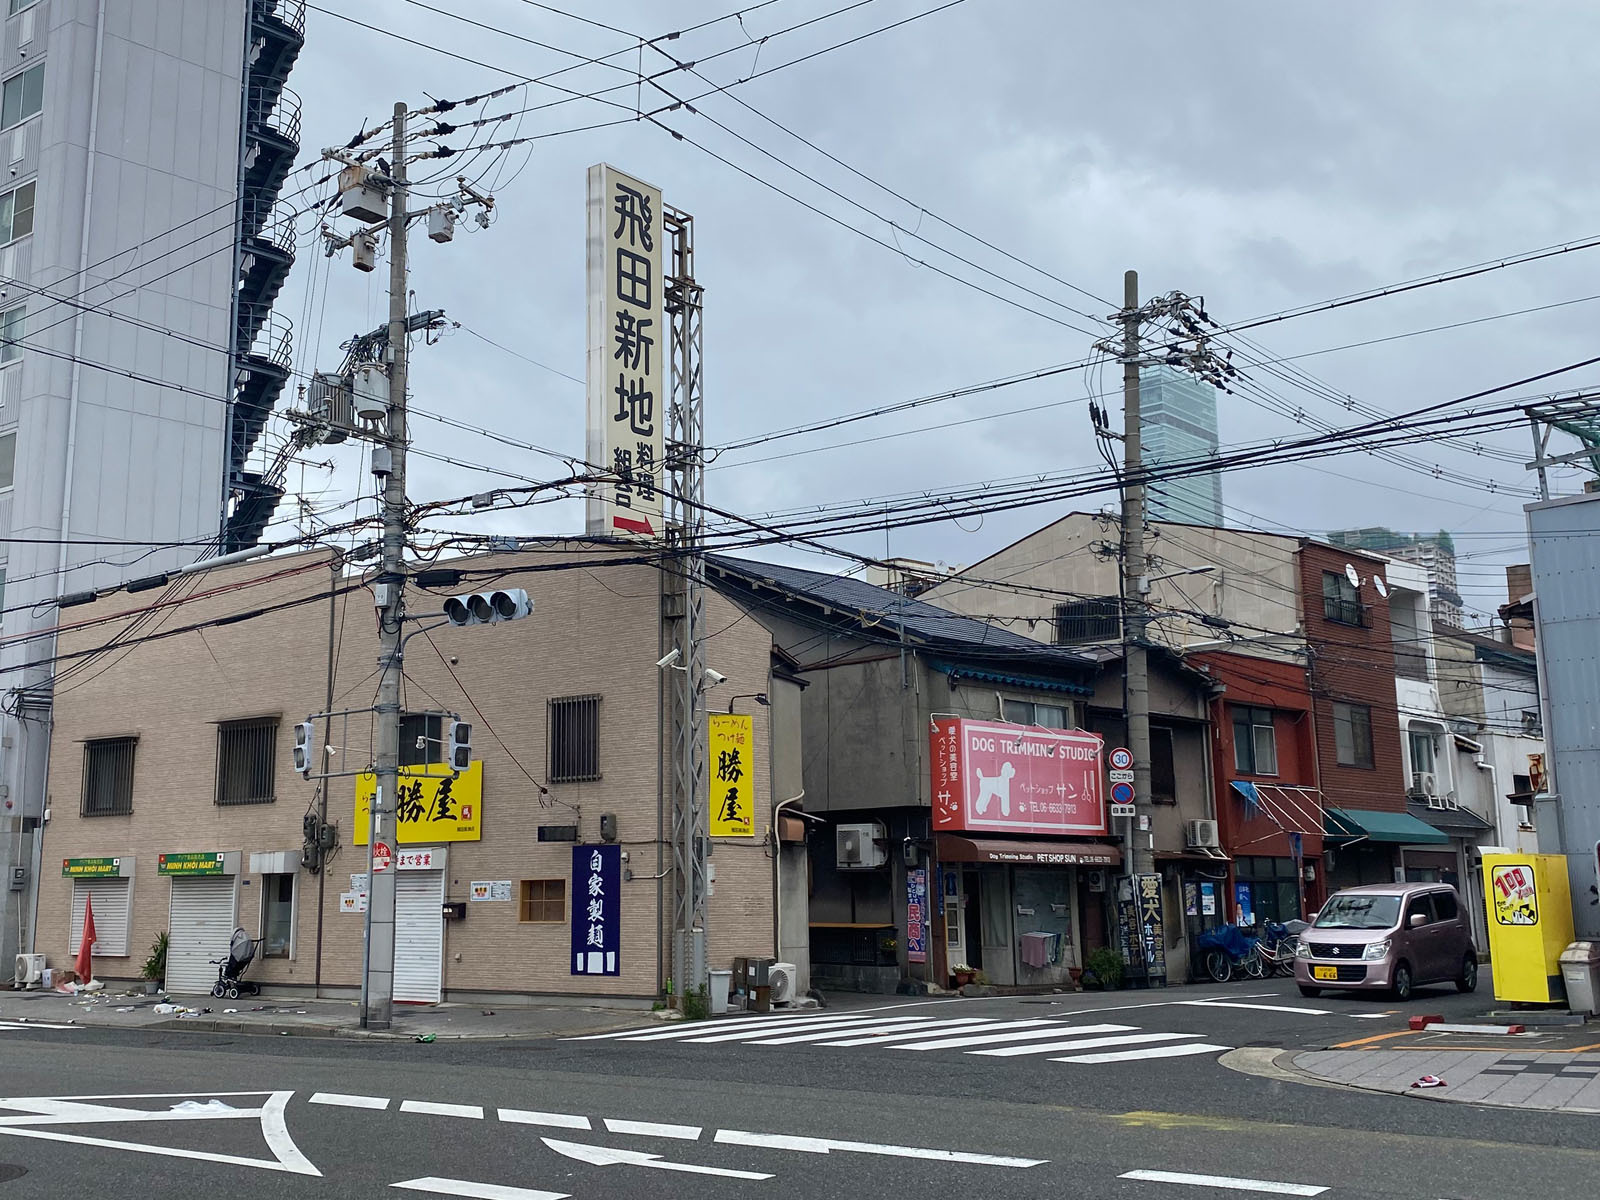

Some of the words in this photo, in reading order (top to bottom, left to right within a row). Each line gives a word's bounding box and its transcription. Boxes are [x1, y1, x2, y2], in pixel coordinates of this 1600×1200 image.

[613, 182, 654, 437] 飛田新地
[636, 441, 655, 502] 料理
[972, 736, 995, 753] DOG
[1115, 754, 1128, 764] 30
[716, 747, 744, 823] 勝屋
[1056, 783, 1078, 799] サン
[937, 790, 952, 824] サン
[373, 846, 388, 857] 火栓
[586, 849, 605, 949] 自家製麺
[1141, 876, 1160, 921] 愛犬
[1495, 868, 1526, 898] 100
[1144, 923, 1155, 963] ホテル
